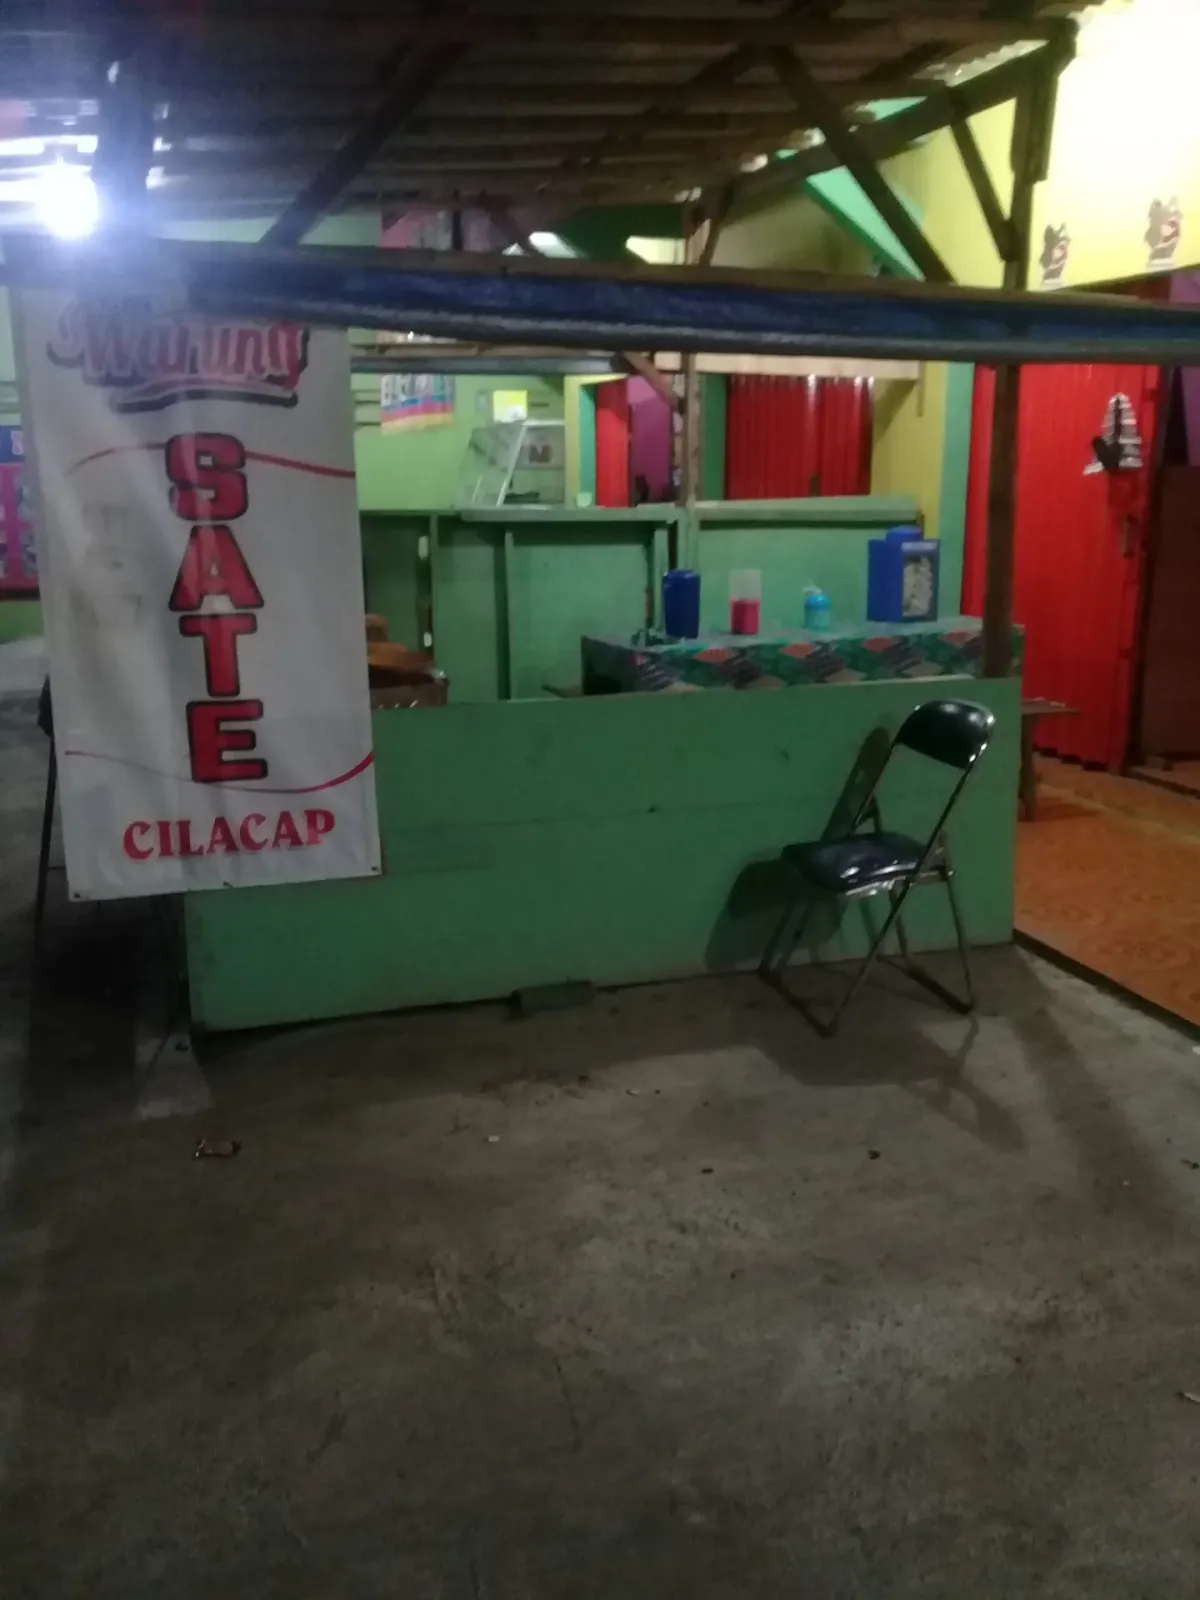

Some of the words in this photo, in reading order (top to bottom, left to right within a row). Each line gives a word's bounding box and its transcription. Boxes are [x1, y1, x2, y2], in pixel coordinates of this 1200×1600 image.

[47, 303, 309, 410] Warung
[165, 432, 267, 783] SATE
[123, 809, 335, 860] CILACAP
